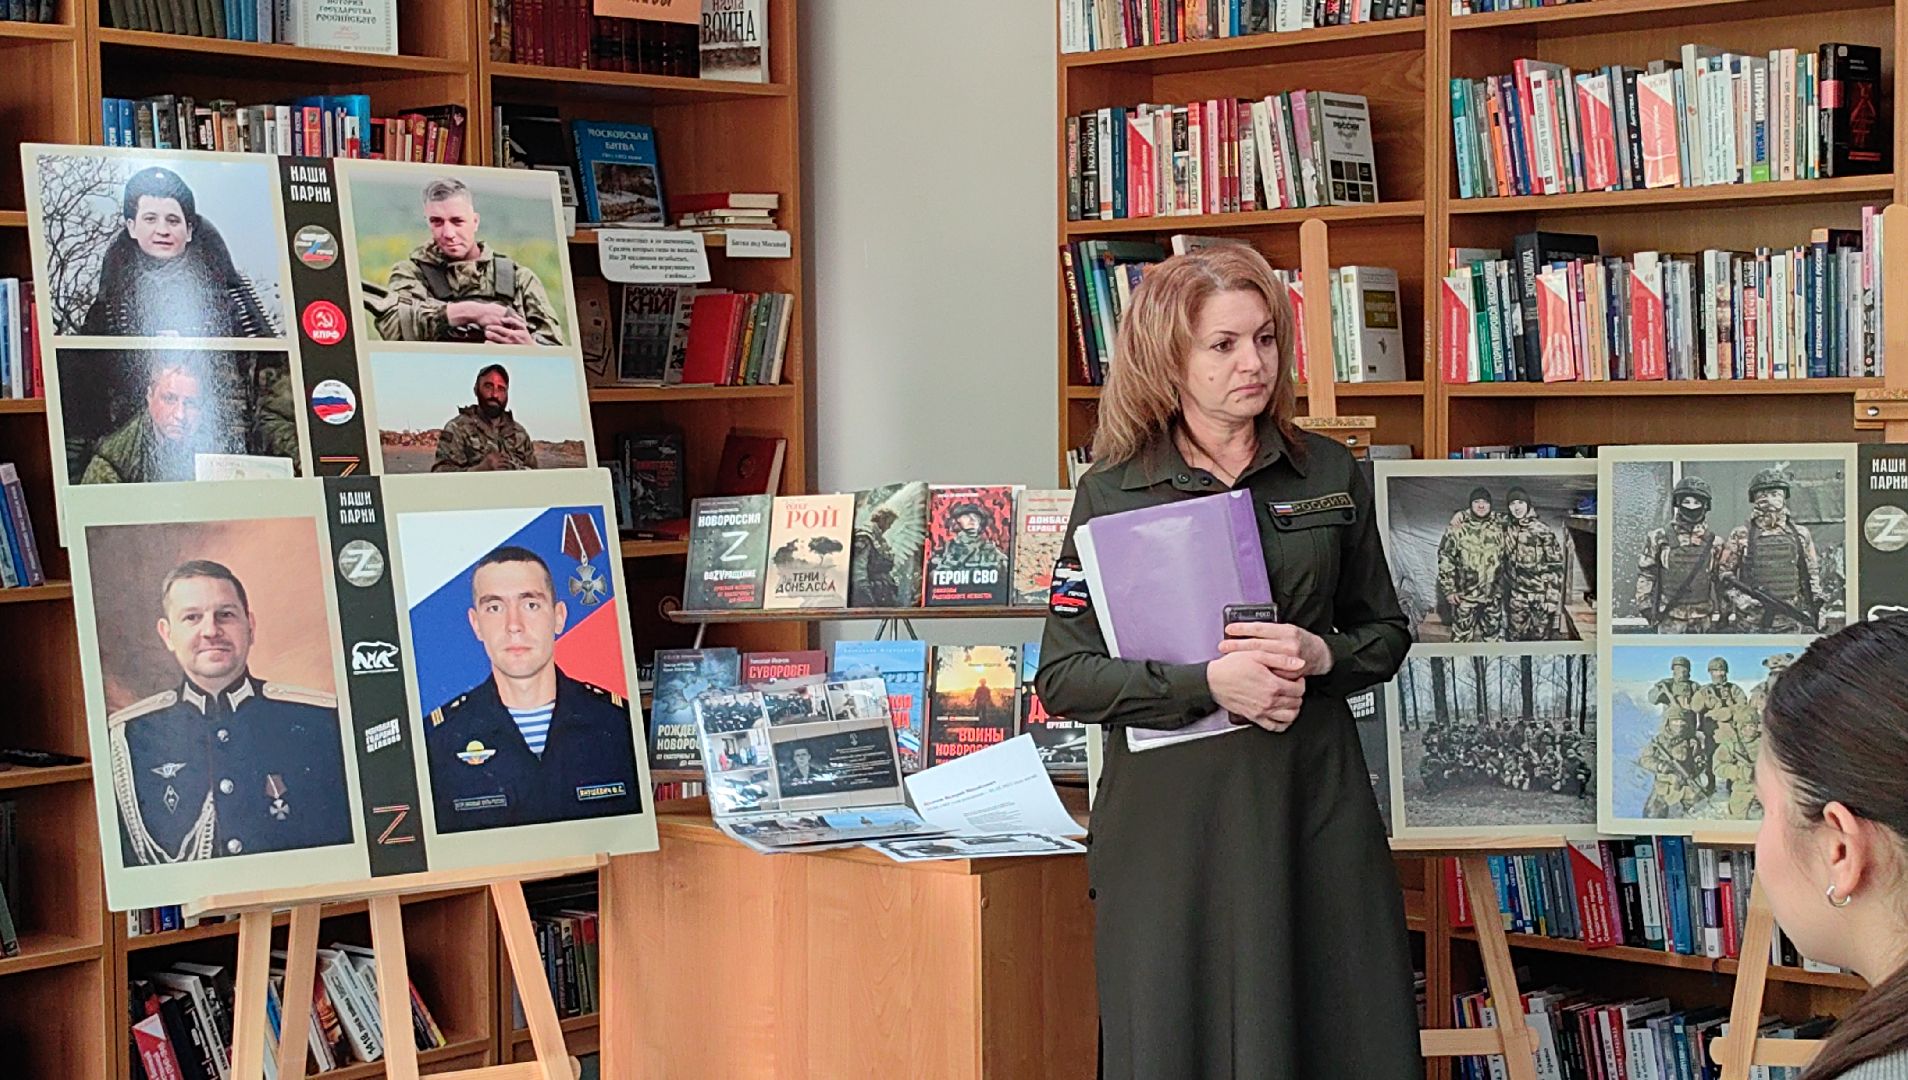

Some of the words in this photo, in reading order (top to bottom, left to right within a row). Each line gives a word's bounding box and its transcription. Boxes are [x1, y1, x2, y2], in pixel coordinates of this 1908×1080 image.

[702, 6, 756, 44] ВОЙНА
[290, 166, 327, 183] НАШИ
[290, 185, 332, 203] ПАРНИ
[626, 287, 679, 298] БЛОКАДН
[313, 330, 340, 340] КПРФ
[1872, 458, 1907, 473] НАШИ
[1870, 475, 1908, 490] ПАРНИ
[339, 491, 372, 507] НАШИ
[1292, 496, 1349, 513] РОССИЯ
[340, 508, 376, 524] ПАРНИ
[698, 512, 761, 527] НОВОРОССИЯ
[786, 505, 840, 529] РОЙ
[1029, 515, 1068, 525] ДОНБАС
[720, 531, 750, 562] Z
[793, 572, 819, 582] ТЕНИ
[933, 570, 970, 585] ГЕРОИ
[973, 569, 998, 584] СВО
[776, 580, 836, 594] ДОНБАССА
[749, 664, 810, 678] СУВОРОВЕЦ
[958, 728, 1004, 742] ВОИНЫ
